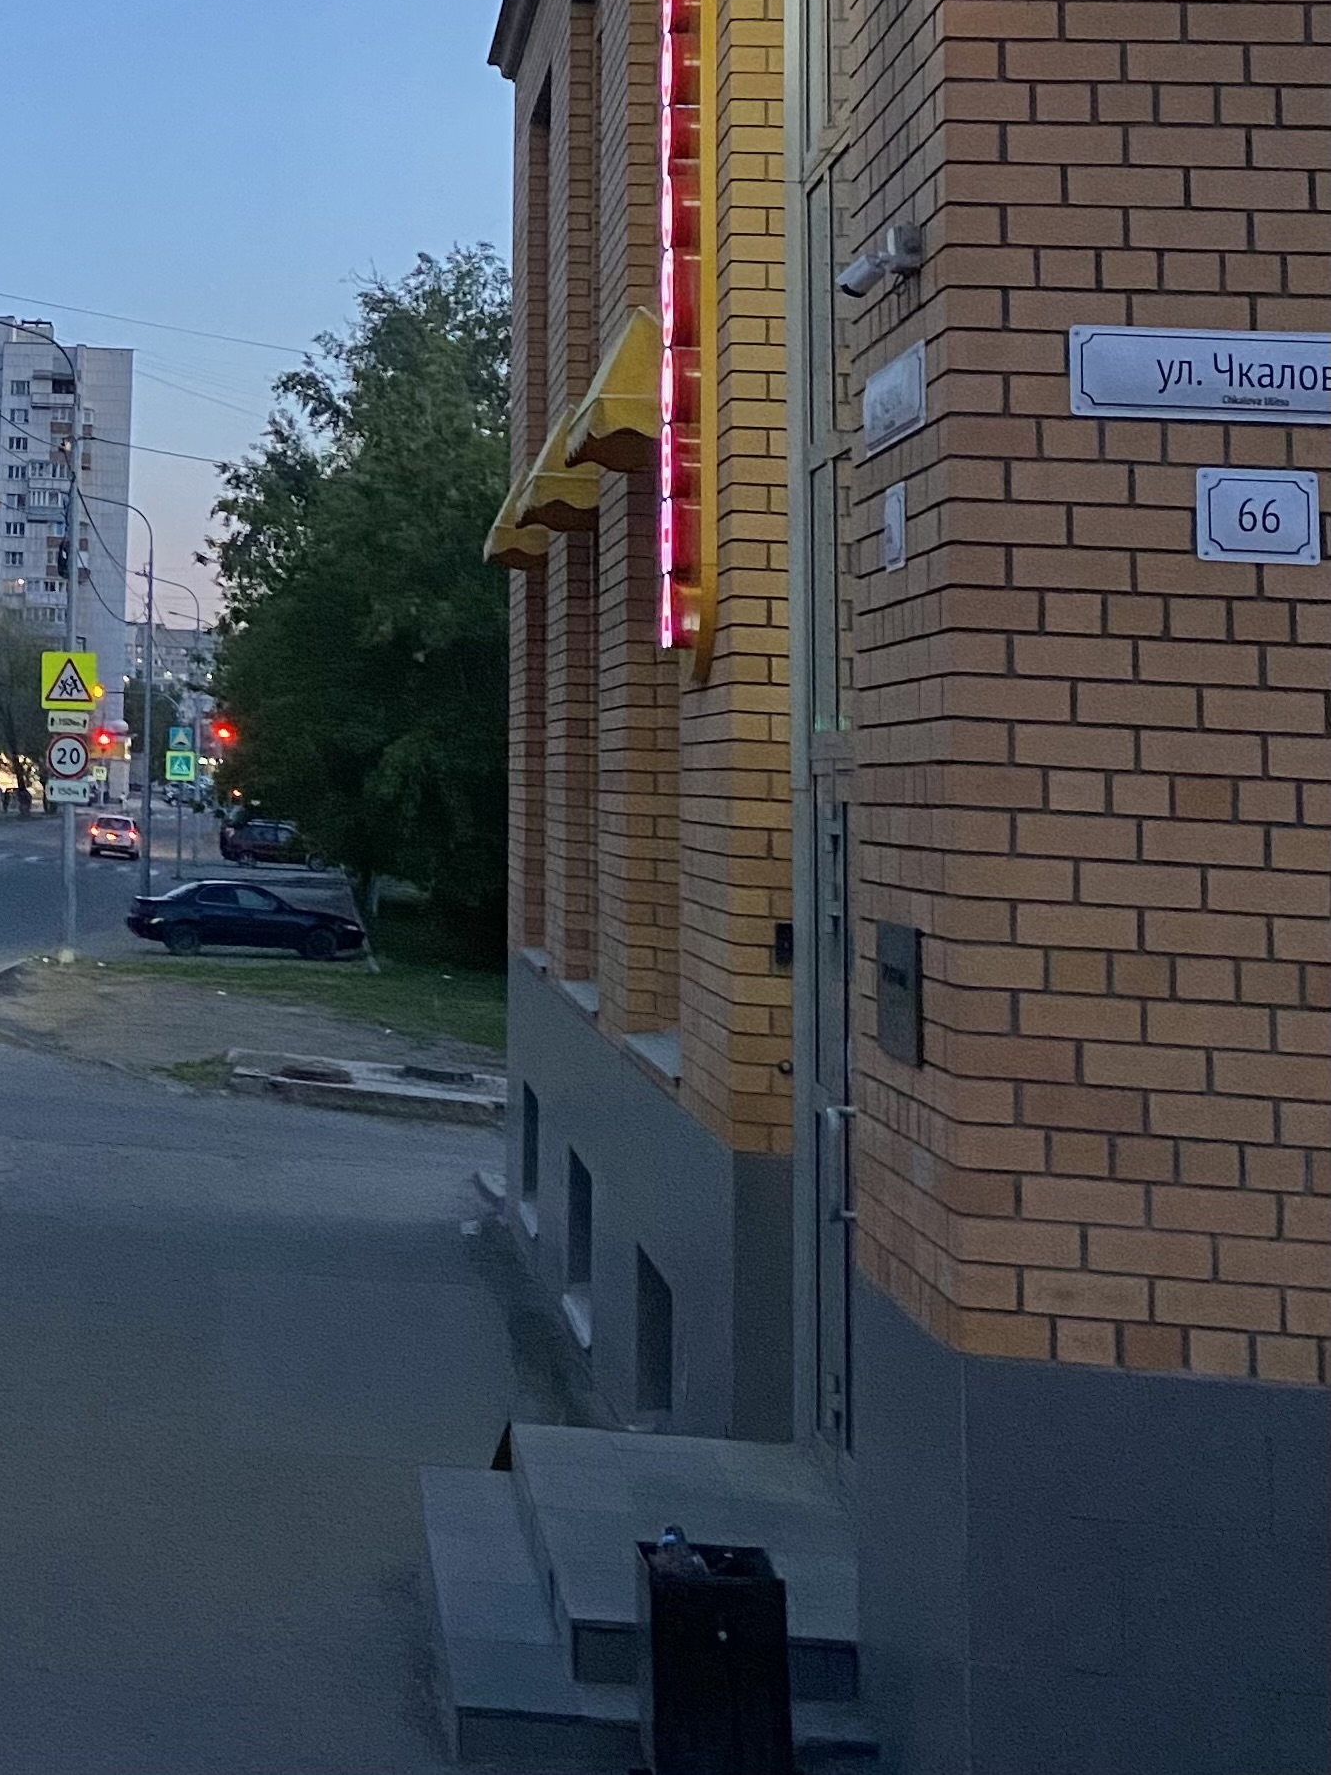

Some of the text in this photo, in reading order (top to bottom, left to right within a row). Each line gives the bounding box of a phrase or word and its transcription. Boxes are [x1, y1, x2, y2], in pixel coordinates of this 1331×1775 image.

[1156, 359, 1203, 394] ул.
[1238, 497, 1281, 534] 66
[56, 747, 80, 765] 20
